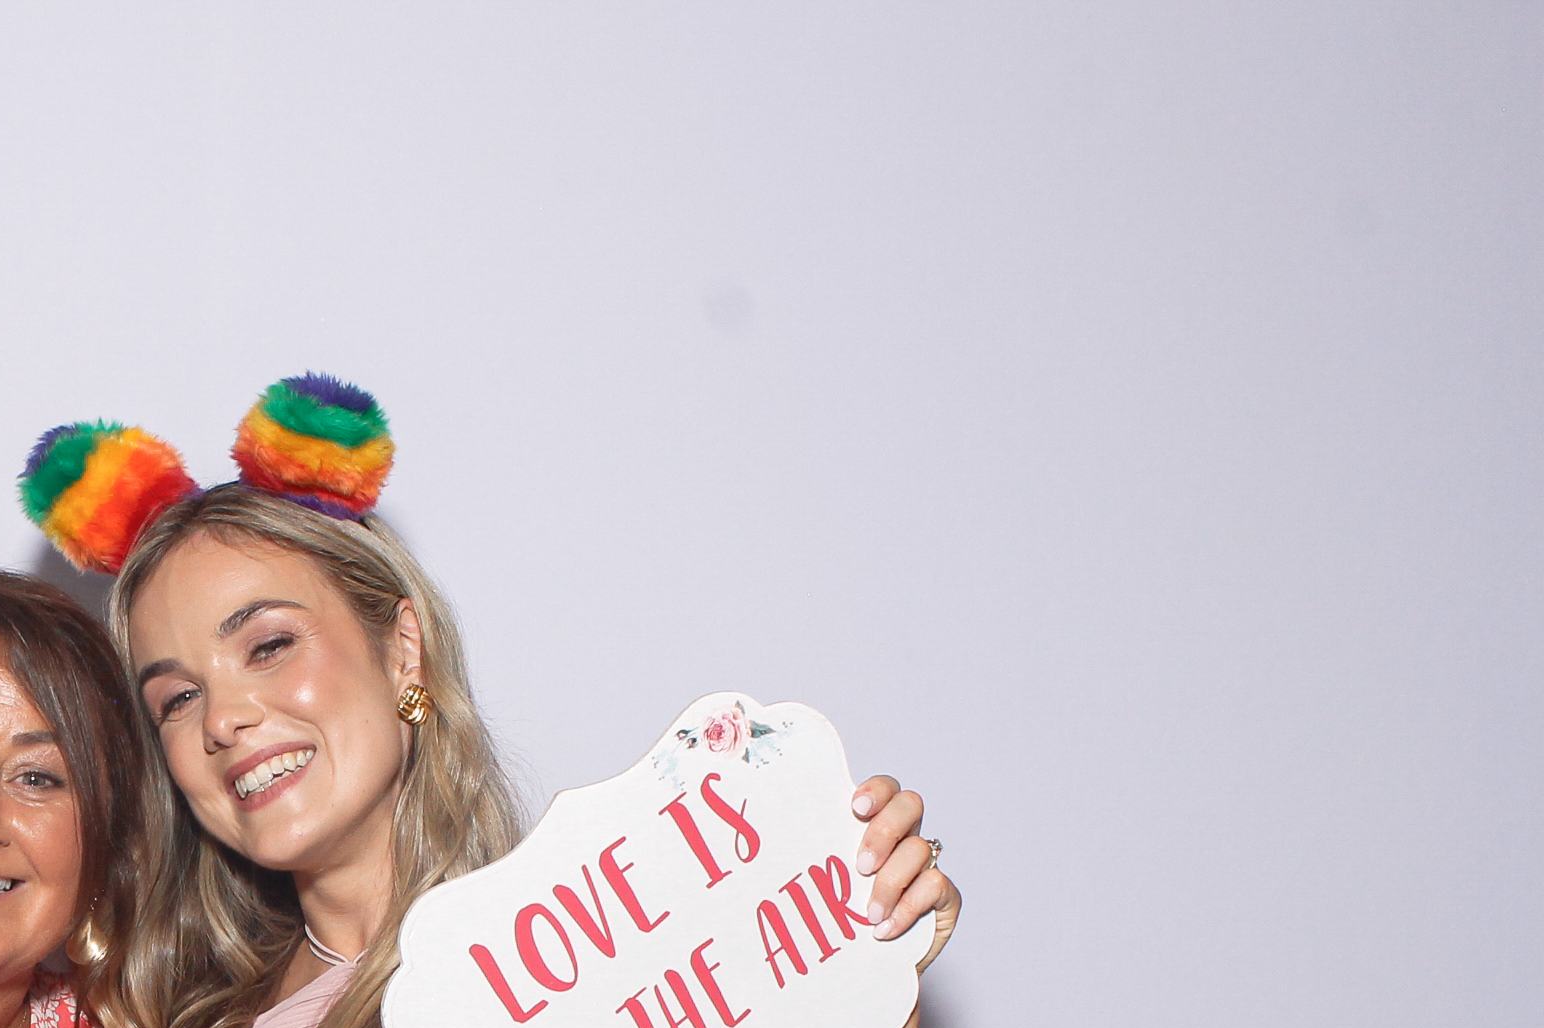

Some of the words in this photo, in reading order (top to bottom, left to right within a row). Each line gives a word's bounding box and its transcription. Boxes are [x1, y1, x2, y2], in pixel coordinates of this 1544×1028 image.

[468, 836, 670, 1023] LOVE
[659, 773, 761, 888] IS
[757, 855, 876, 988] AIR
